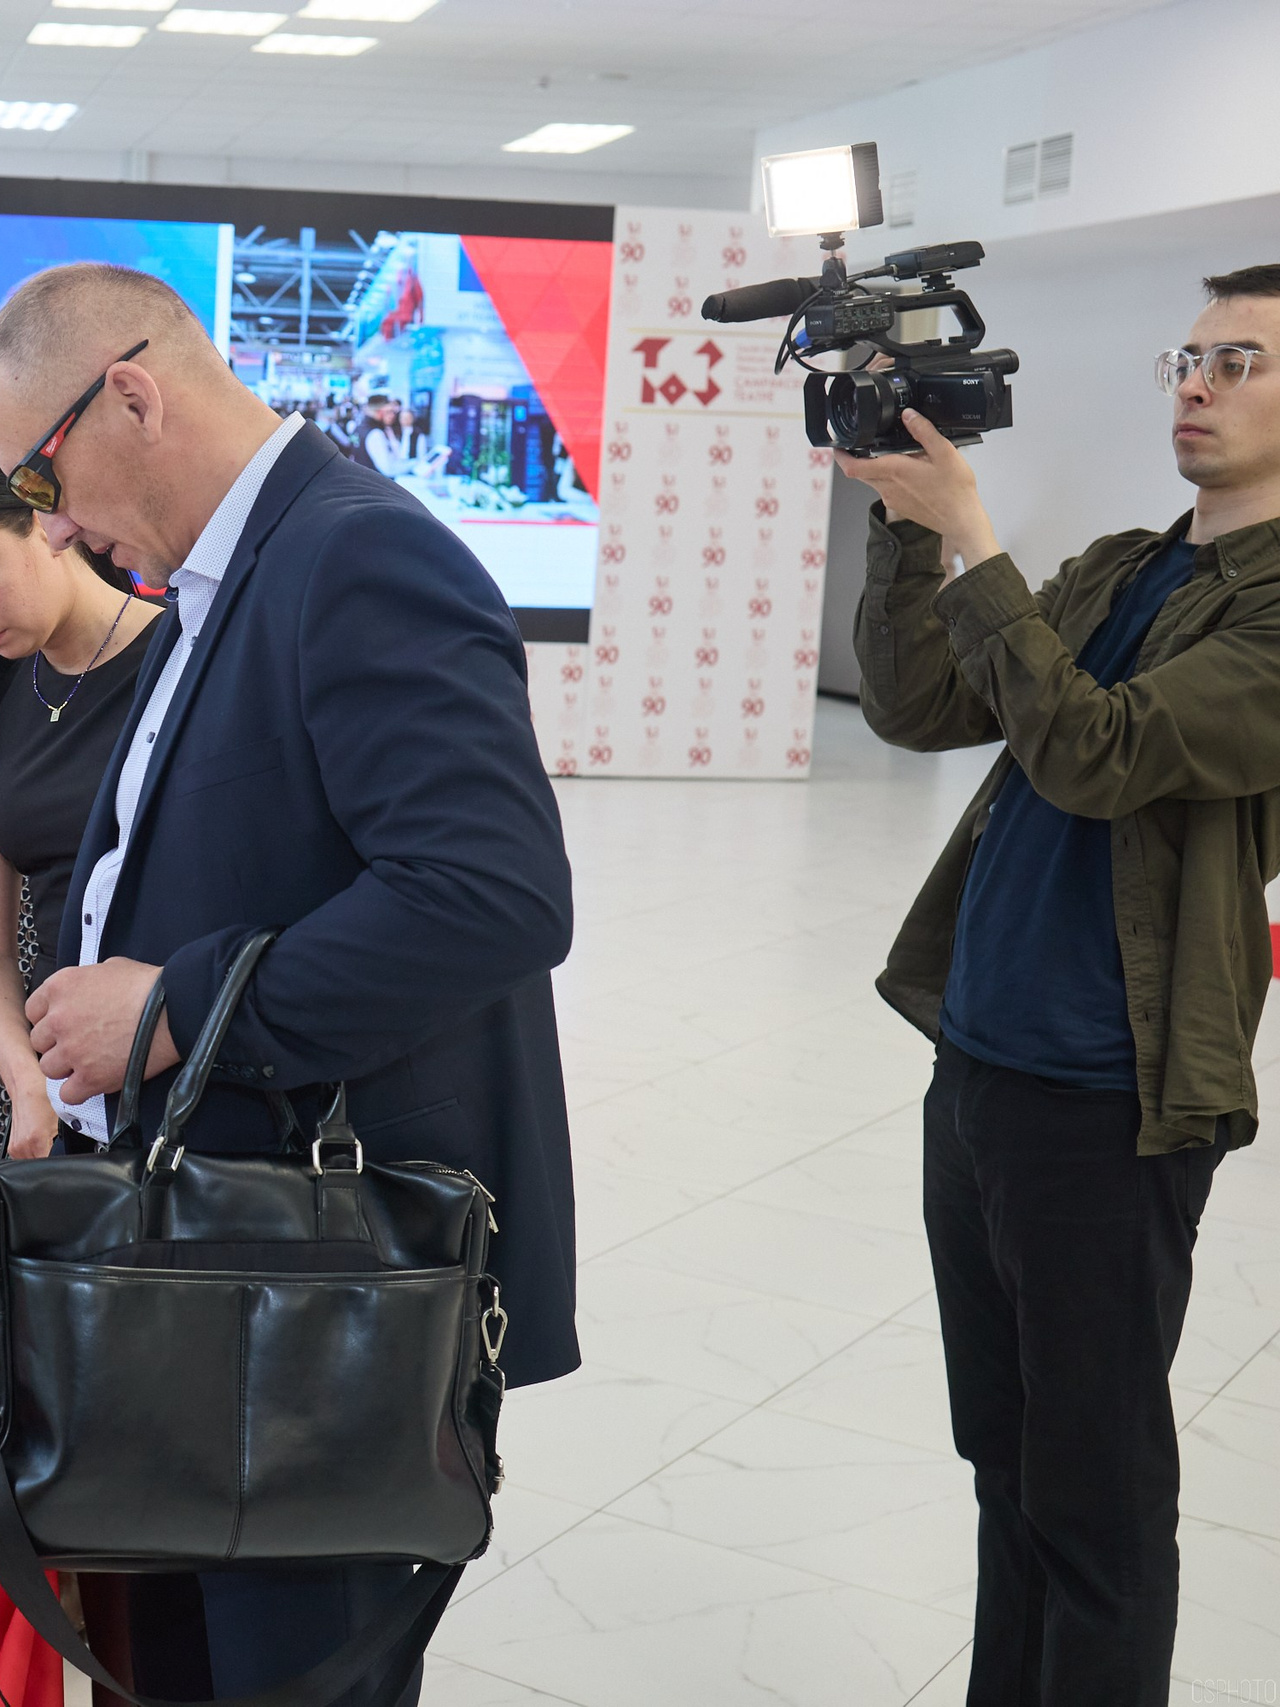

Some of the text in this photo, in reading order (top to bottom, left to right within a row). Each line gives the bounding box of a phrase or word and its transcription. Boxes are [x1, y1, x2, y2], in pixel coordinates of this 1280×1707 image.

[620, 242, 645, 262] 90
[722, 248, 747, 268] 90
[668, 297, 693, 317] 90
[607, 441, 632, 461] 90
[708, 445, 733, 465] 90
[809, 448, 832, 468] 90
[655, 495, 679, 515] 90
[755, 498, 780, 518] 90
[602, 544, 626, 564] 90
[702, 546, 726, 566] 90
[801, 549, 826, 569] 90
[648, 595, 673, 615] 90
[748, 598, 772, 618] 90
[595, 645, 619, 665] 90
[695, 647, 719, 667] 90
[794, 649, 818, 669] 90
[561, 663, 584, 683] 90
[642, 696, 667, 716] 90
[741, 698, 765, 718] 90
[589, 745, 613, 765] 90
[688, 746, 712, 766] 90
[786, 747, 810, 767] 90
